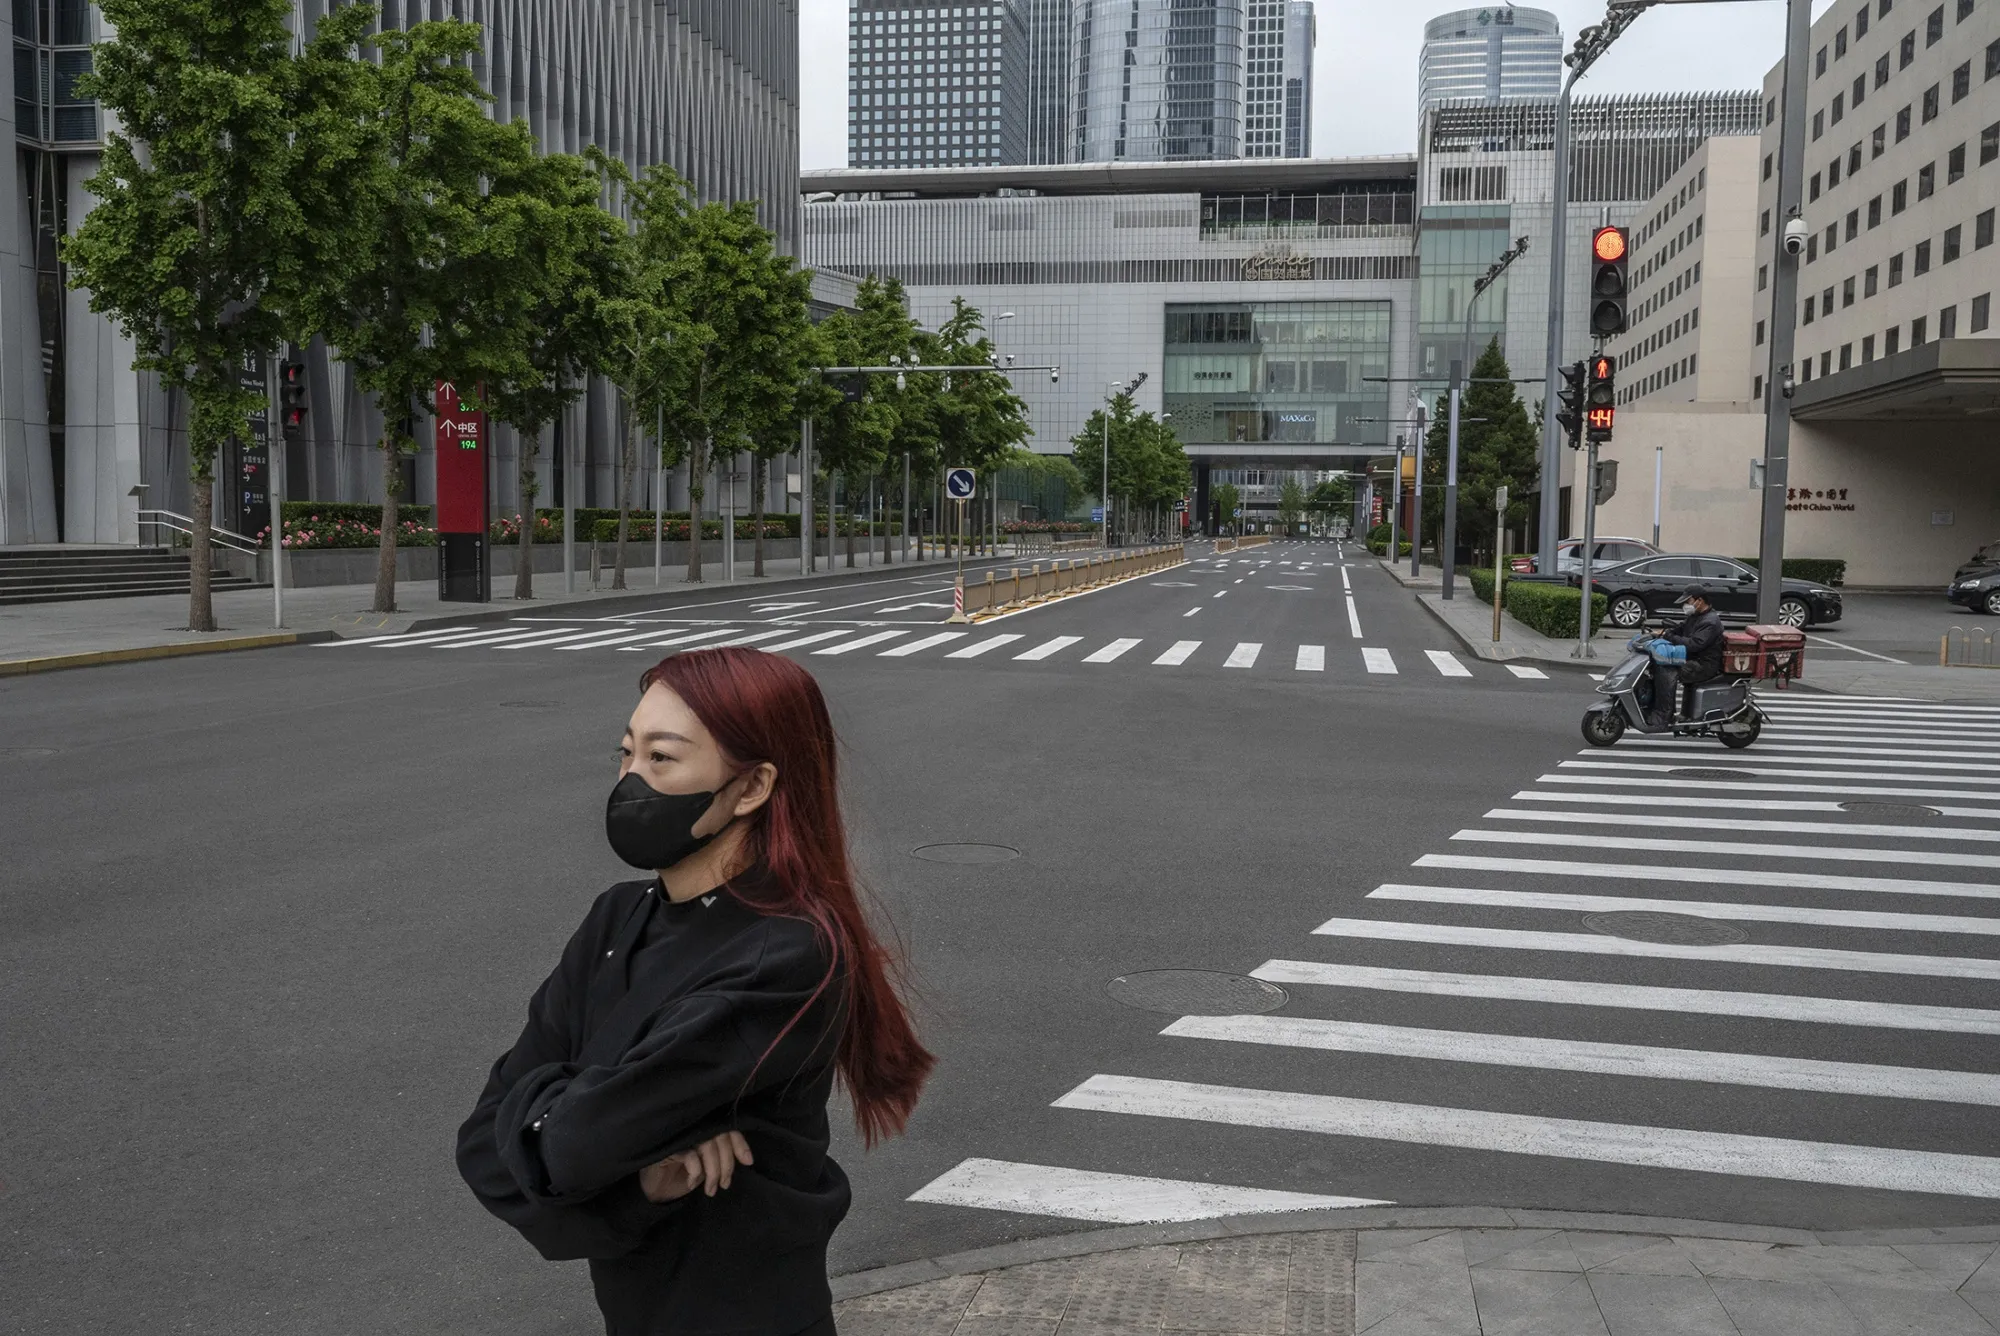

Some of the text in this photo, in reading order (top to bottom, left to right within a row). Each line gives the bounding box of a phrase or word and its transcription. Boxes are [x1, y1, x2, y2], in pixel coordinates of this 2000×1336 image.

[1590, 409, 1612, 427] 44
[458, 422, 477, 433] 中区
[461, 440, 476, 449] 194
[1832, 503, 1855, 511] World
